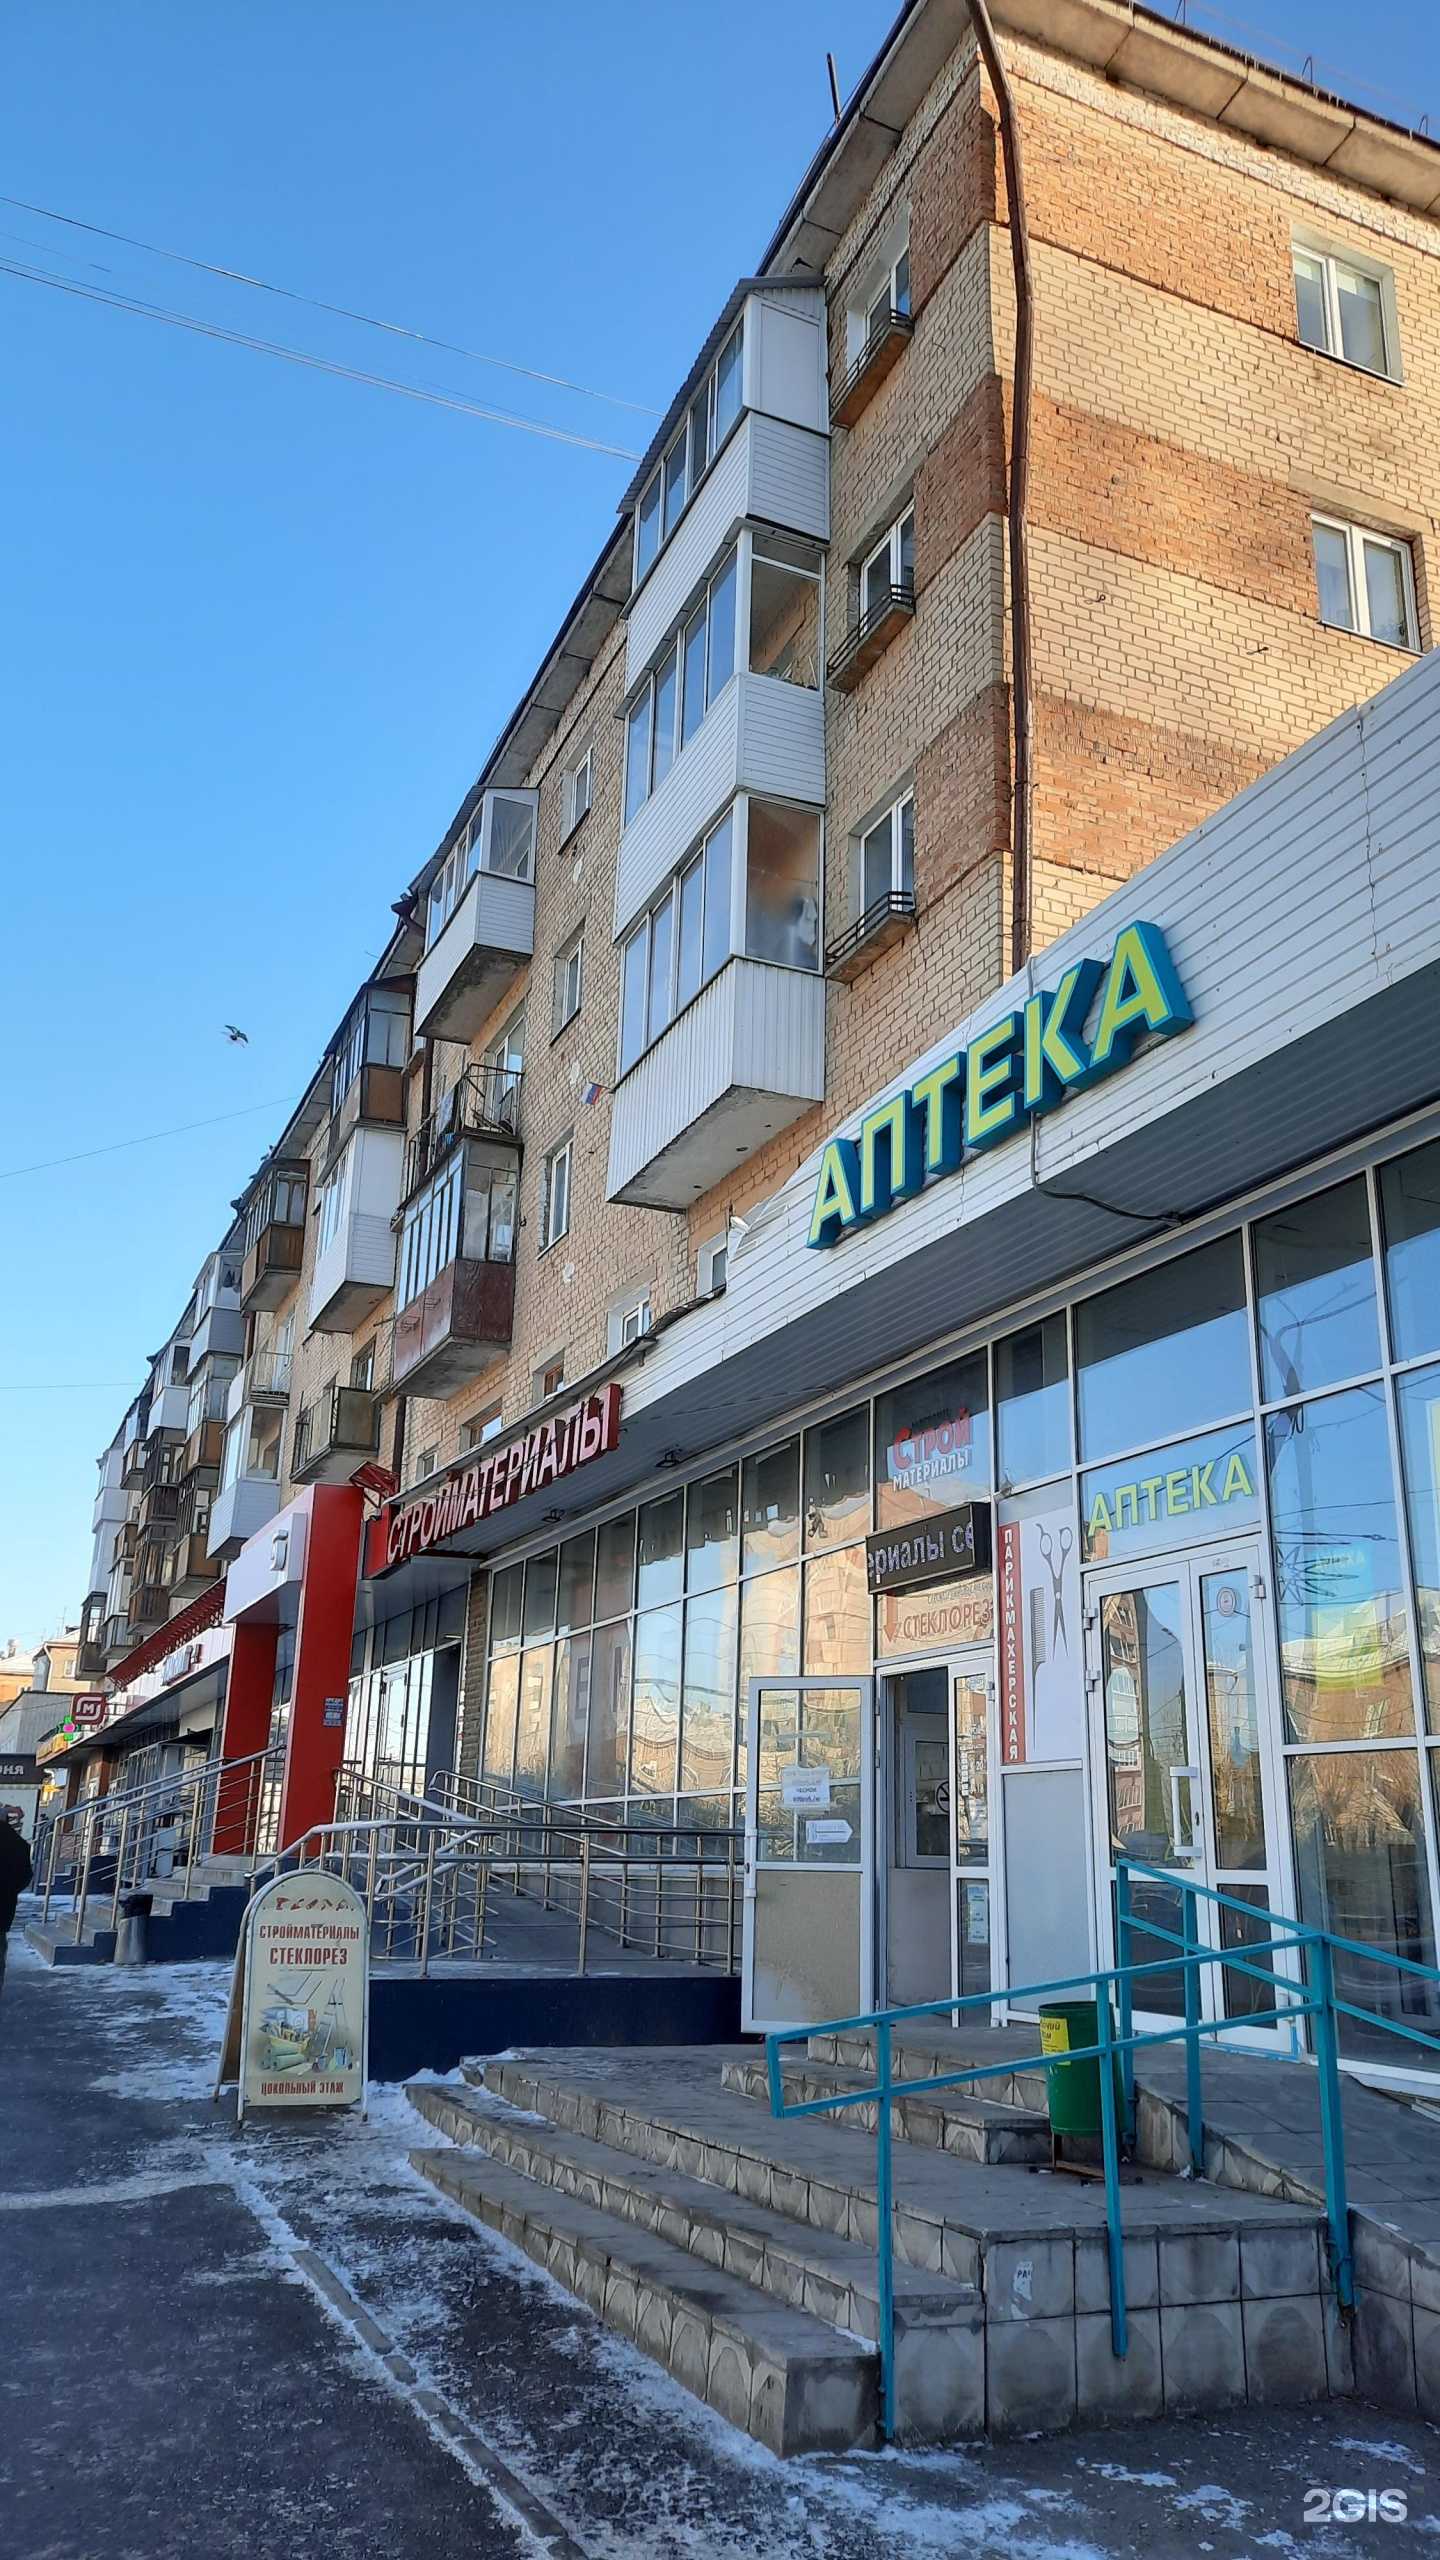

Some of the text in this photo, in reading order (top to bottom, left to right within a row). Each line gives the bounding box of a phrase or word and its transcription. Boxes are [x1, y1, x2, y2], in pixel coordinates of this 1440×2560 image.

[807, 920, 1194, 1249] АПТЕКА
[387, 1383, 622, 1563] СТРОЙМАТЕРИАЛЫ
[893, 1448, 970, 1492] МАТЕРИАЛЫ
[1088, 1454, 1253, 1537] АПТЕКА
[1004, 1528, 1018, 1760] ПАРИКМАХЕРСКАЯ
[259, 1924, 360, 1940] СТРОЙМАТЕРИАЛЫ
[269, 1947, 348, 1965] СТЕКЛОРЕЗ
[261, 2080, 344, 2096] ЦОКОЛЬНЫЙ ЭТАЖ
